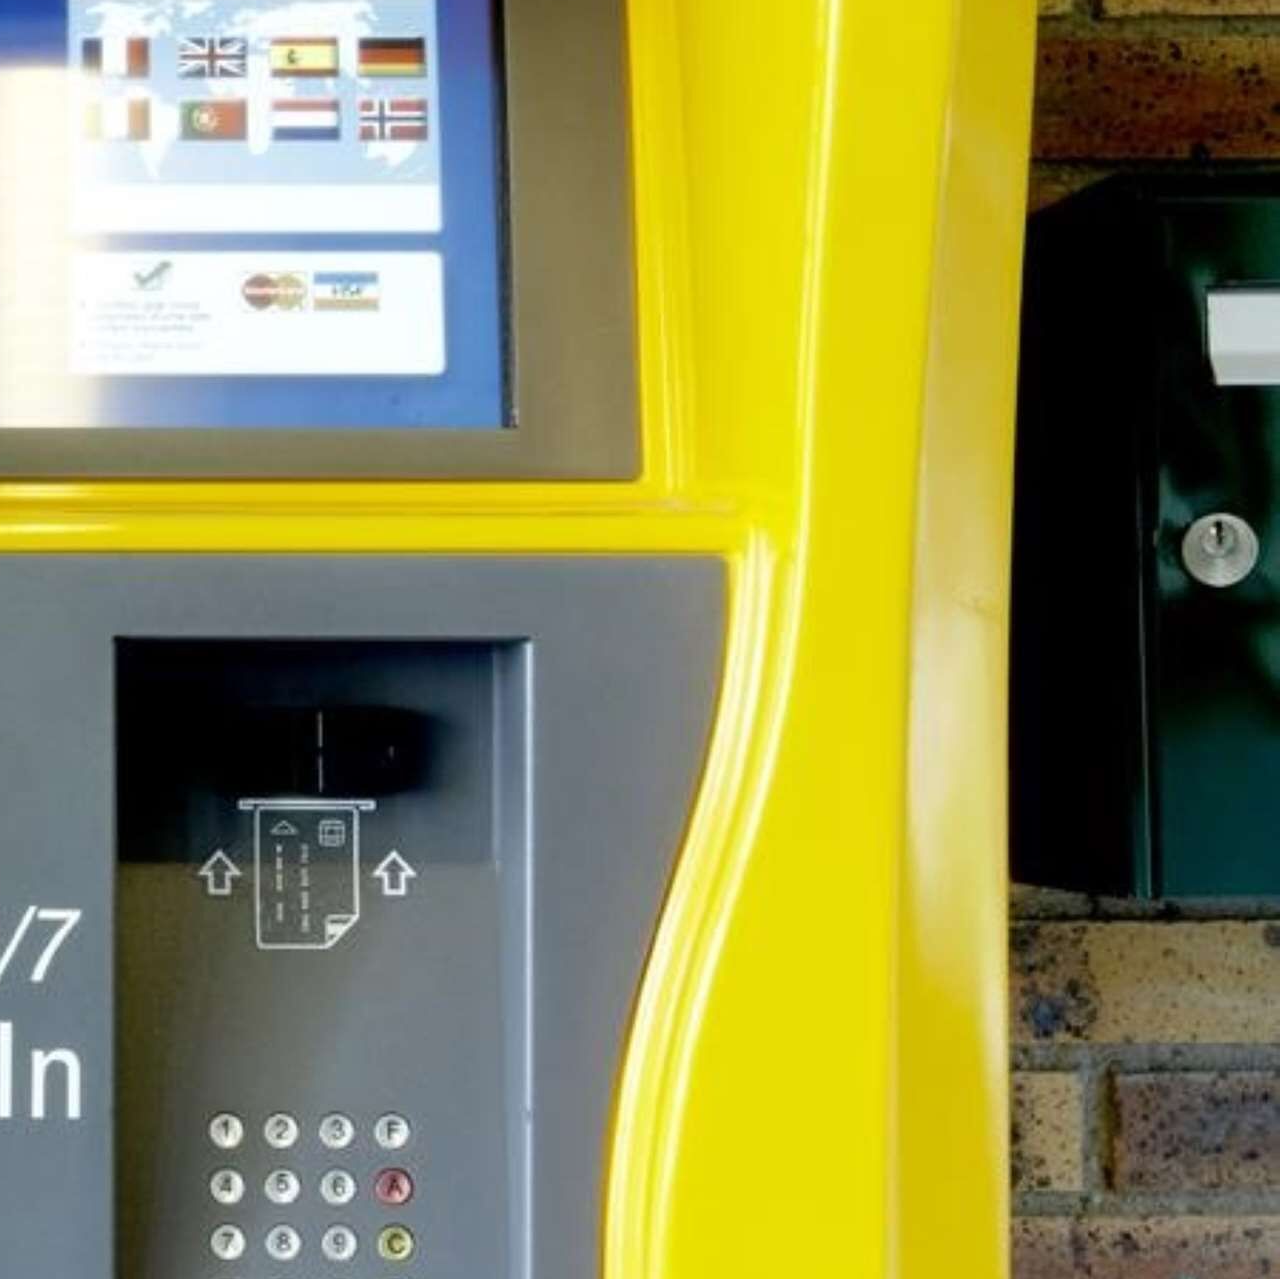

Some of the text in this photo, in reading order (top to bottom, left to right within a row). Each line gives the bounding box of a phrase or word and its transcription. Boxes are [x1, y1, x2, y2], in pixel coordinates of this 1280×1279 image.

[274, 1119, 290, 1140] 2
[330, 1119, 346, 1140] 3
[386, 1121, 402, 1141] F
[219, 1173, 404, 1197] 4 5 6 A
[220, 1231, 406, 1254] 7 8 9 C
